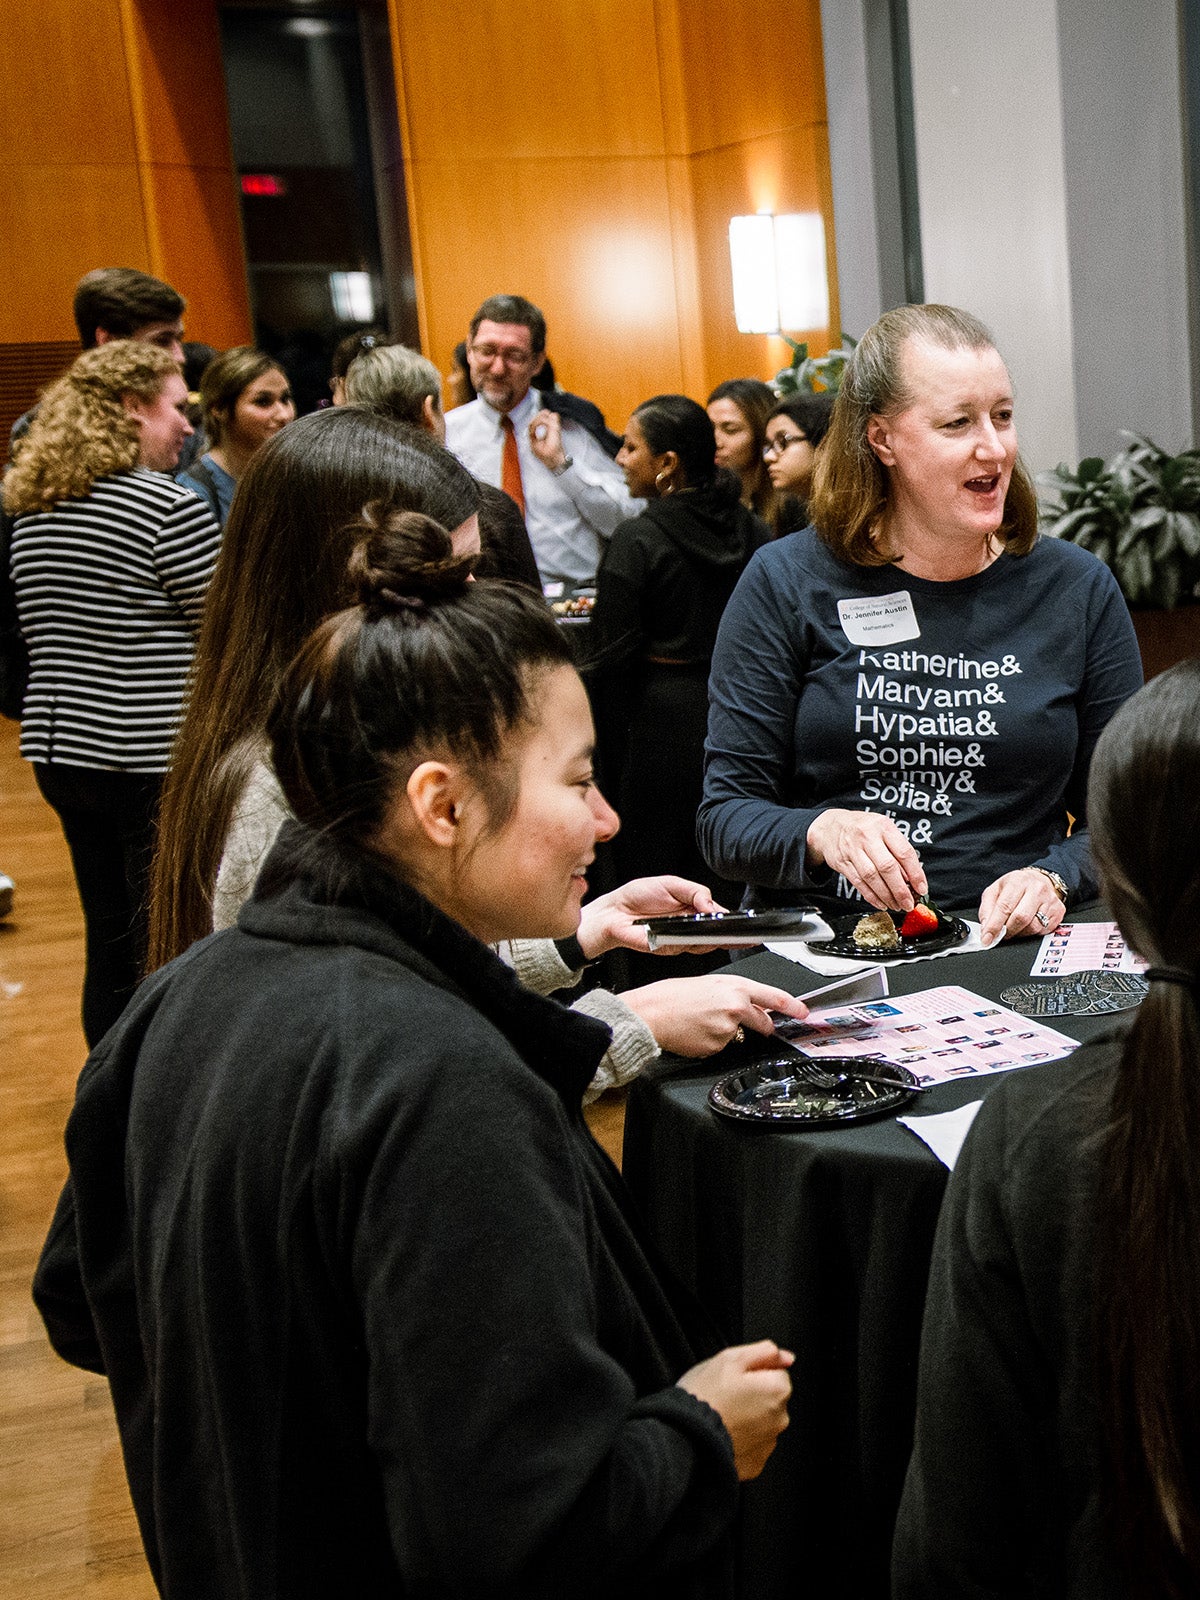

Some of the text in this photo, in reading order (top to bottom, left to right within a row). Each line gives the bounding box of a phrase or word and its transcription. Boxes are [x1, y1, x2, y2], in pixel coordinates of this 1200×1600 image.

[855, 609, 883, 619] Jennifer
[885, 605, 908, 614] Austin
[859, 650, 1023, 680] Katherine&
[856, 672, 1007, 711] Maryam&
[855, 705, 999, 742] Hypatia&
[856, 739, 987, 770] Sophie&
[860, 778, 953, 817] Sofia&
